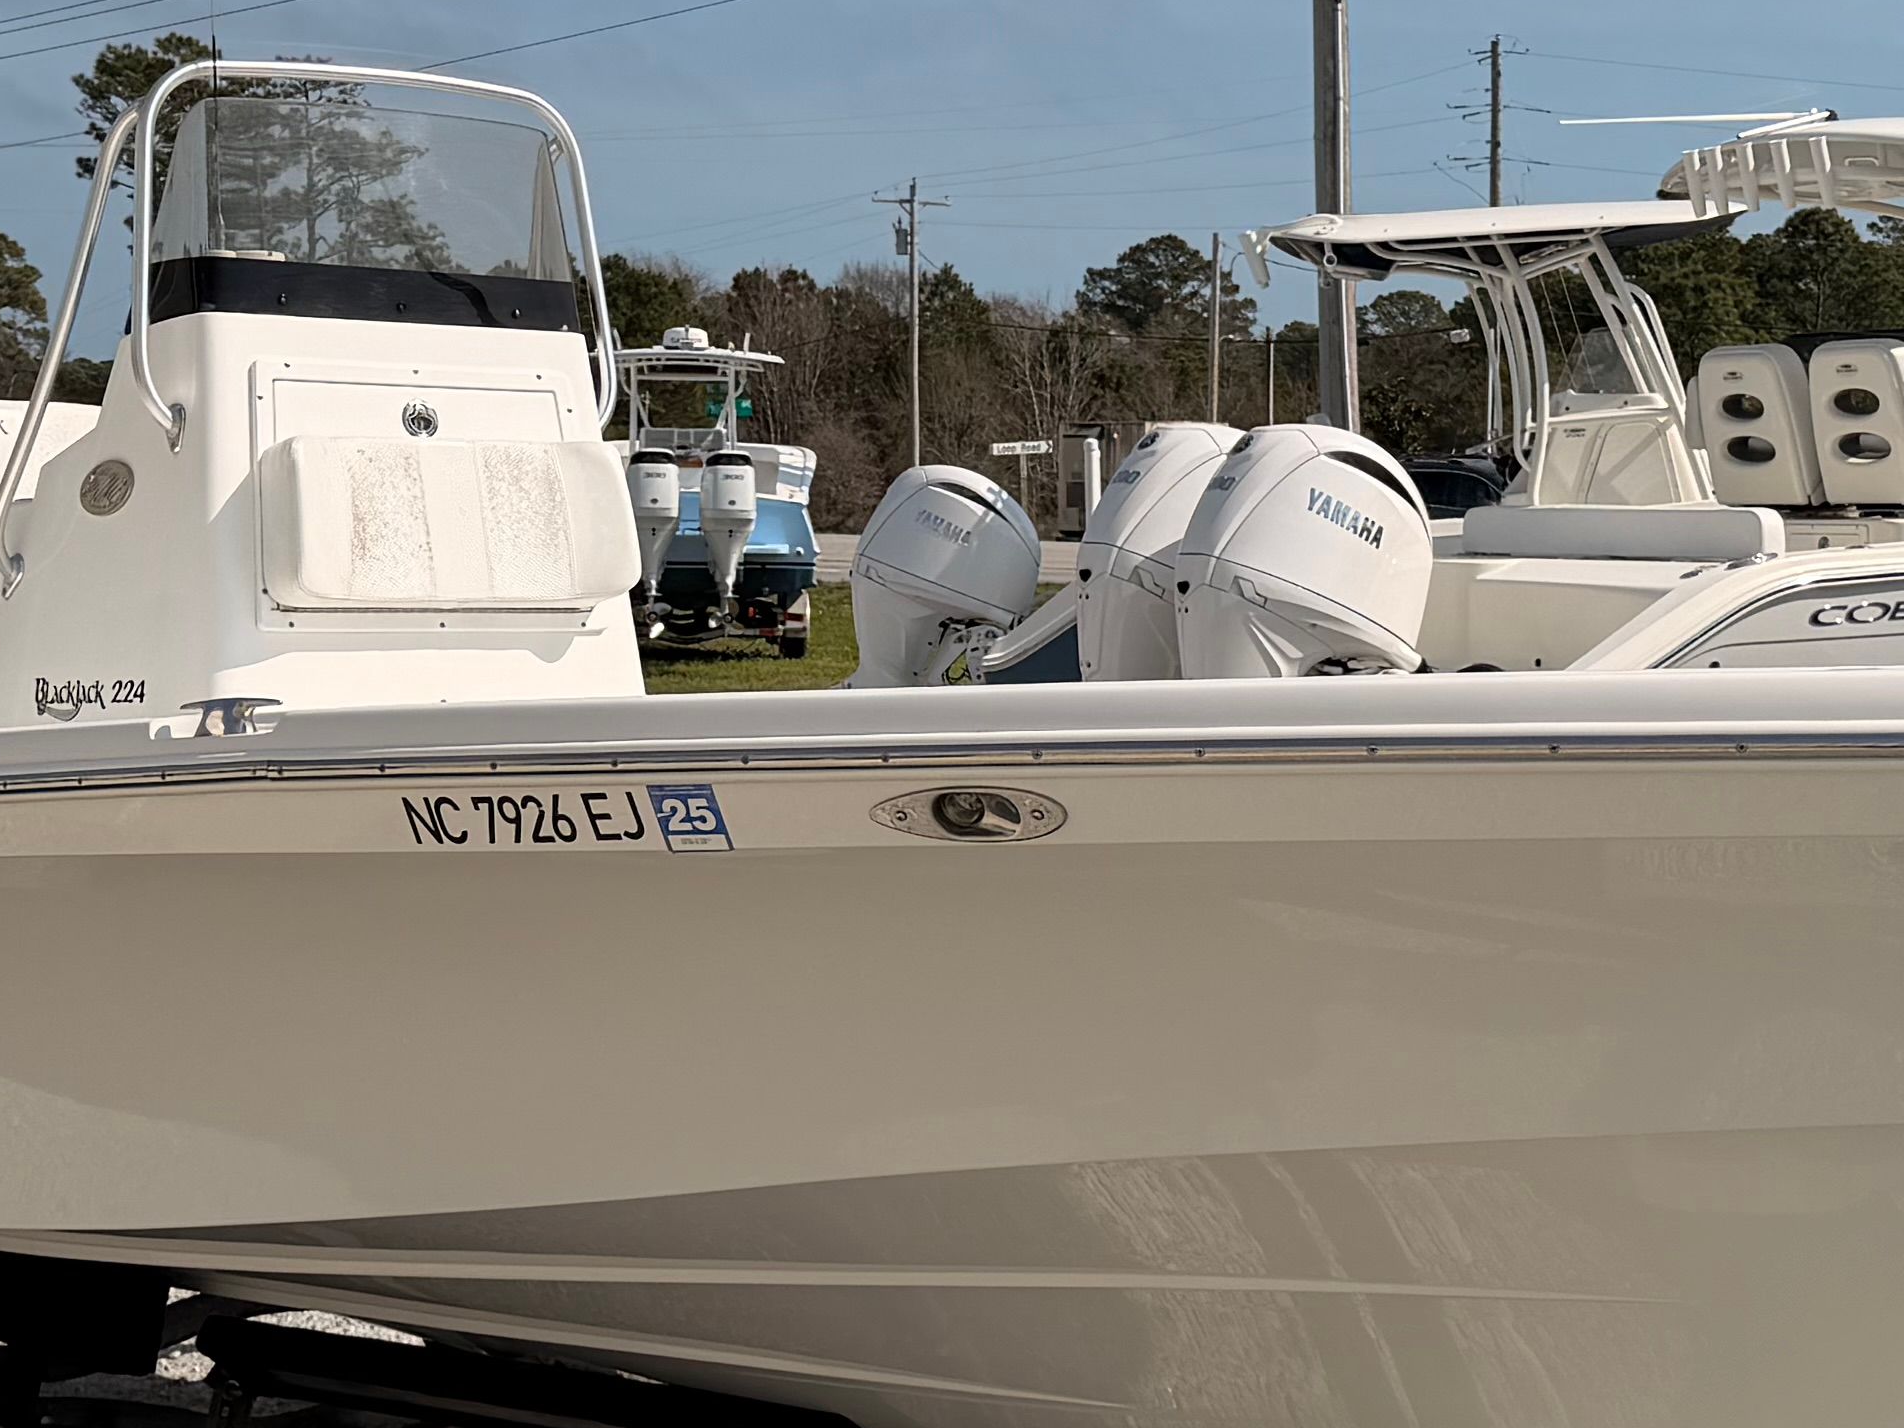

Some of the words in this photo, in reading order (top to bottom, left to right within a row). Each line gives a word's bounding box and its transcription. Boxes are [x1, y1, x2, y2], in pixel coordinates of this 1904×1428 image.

[917, 508, 973, 547] YAMAHA
[1306, 487, 1385, 550] YAMAHA
[110, 679, 146, 703] 224
[401, 797, 468, 844] NC
[471, 794, 577, 844] 7926
[580, 791, 645, 841] EJ
[658, 798, 717, 831] 25
